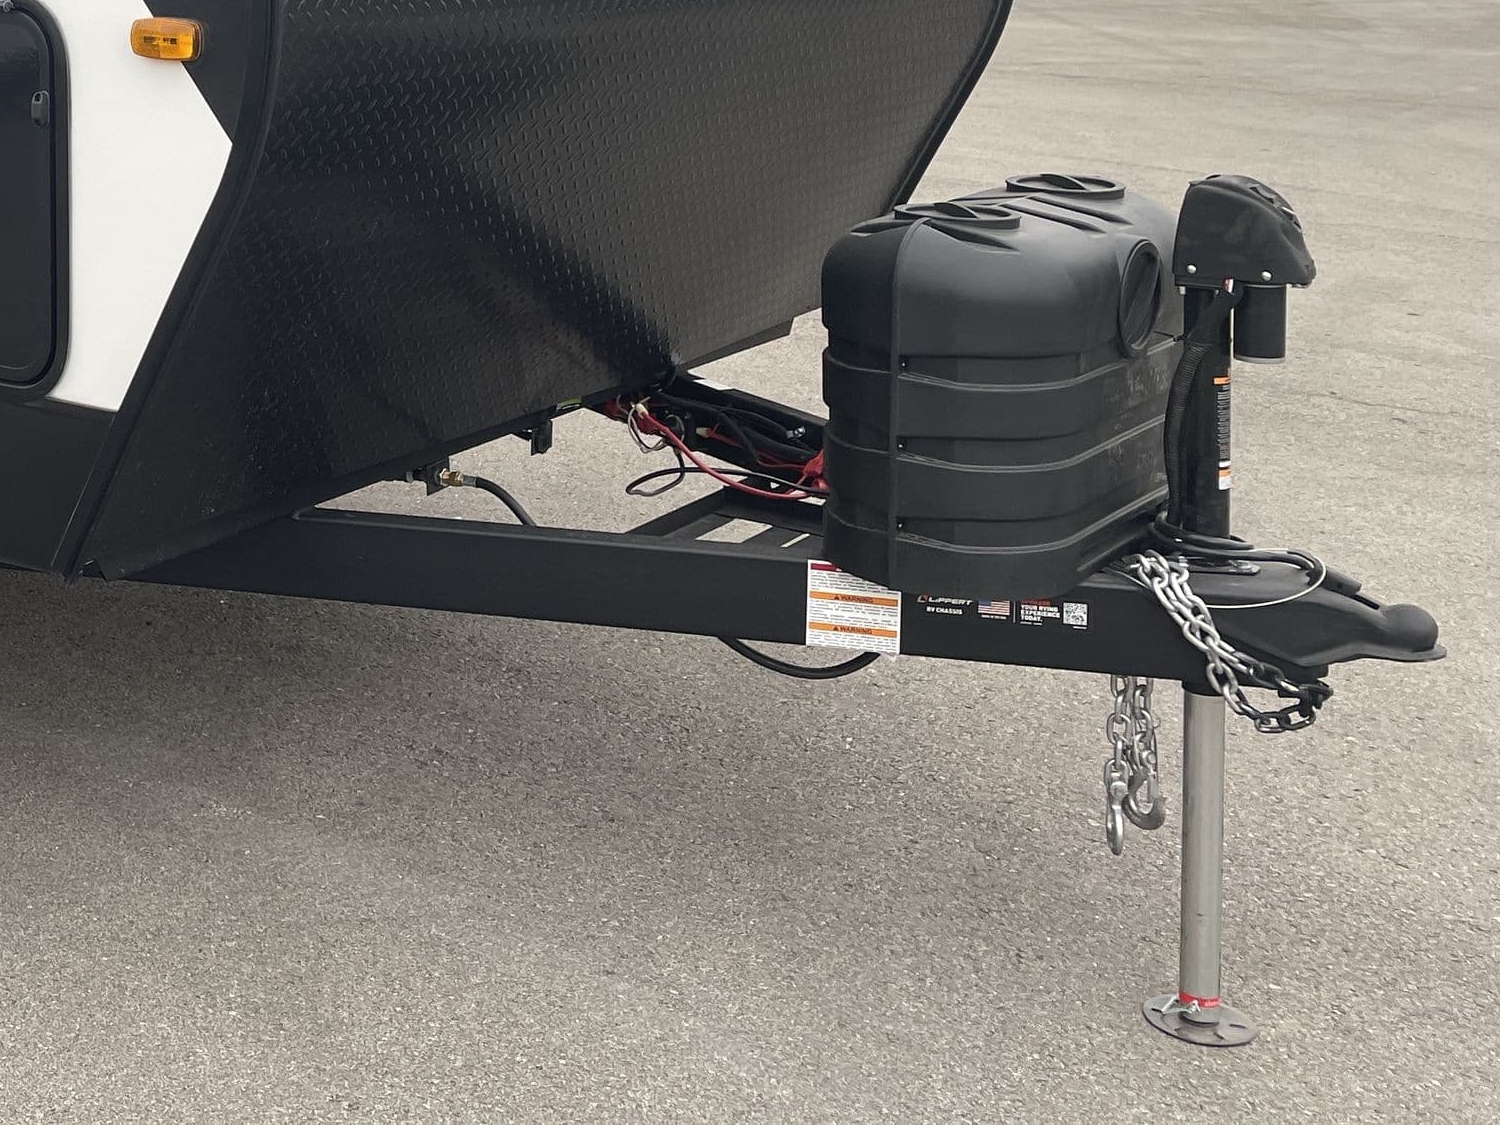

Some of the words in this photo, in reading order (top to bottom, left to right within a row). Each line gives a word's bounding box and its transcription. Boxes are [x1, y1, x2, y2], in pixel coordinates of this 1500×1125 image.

[840, 594, 873, 604] WARNING
[936, 607, 963, 615] CHASSIS
[839, 626, 872, 635] WARNING
